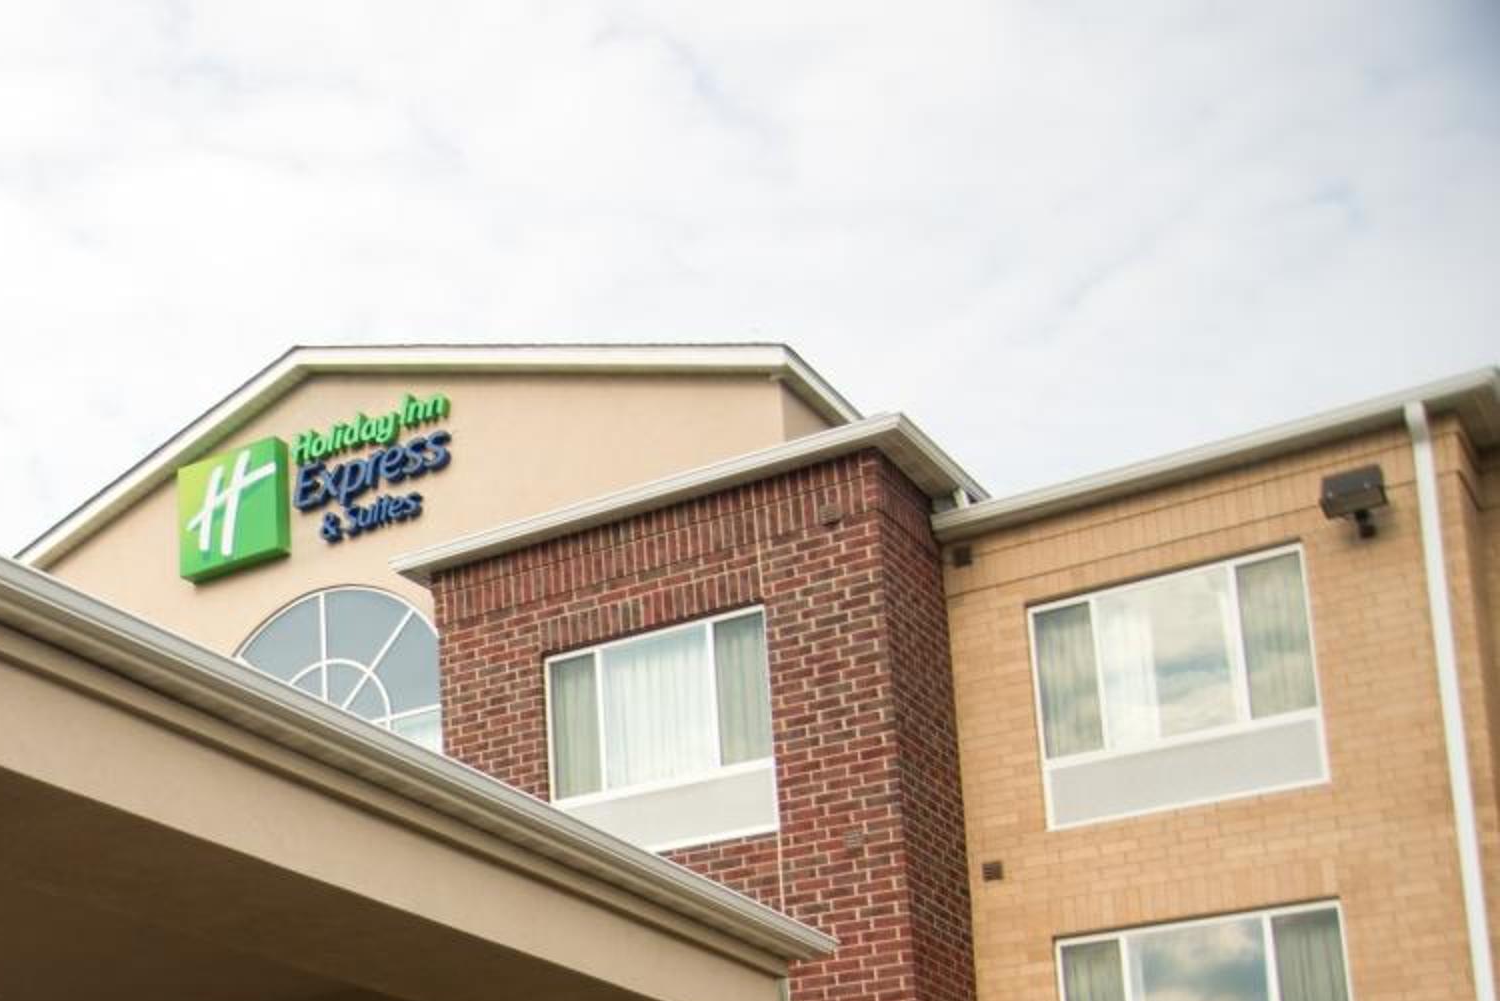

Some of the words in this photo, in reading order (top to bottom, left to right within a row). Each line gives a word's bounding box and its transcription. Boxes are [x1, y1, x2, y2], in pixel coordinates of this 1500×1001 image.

[292, 411, 401, 465] Holiday
[400, 393, 451, 430] Inn
[293, 431, 452, 512] Express
[320, 511, 343, 544] &
[342, 491, 424, 537] Suites
